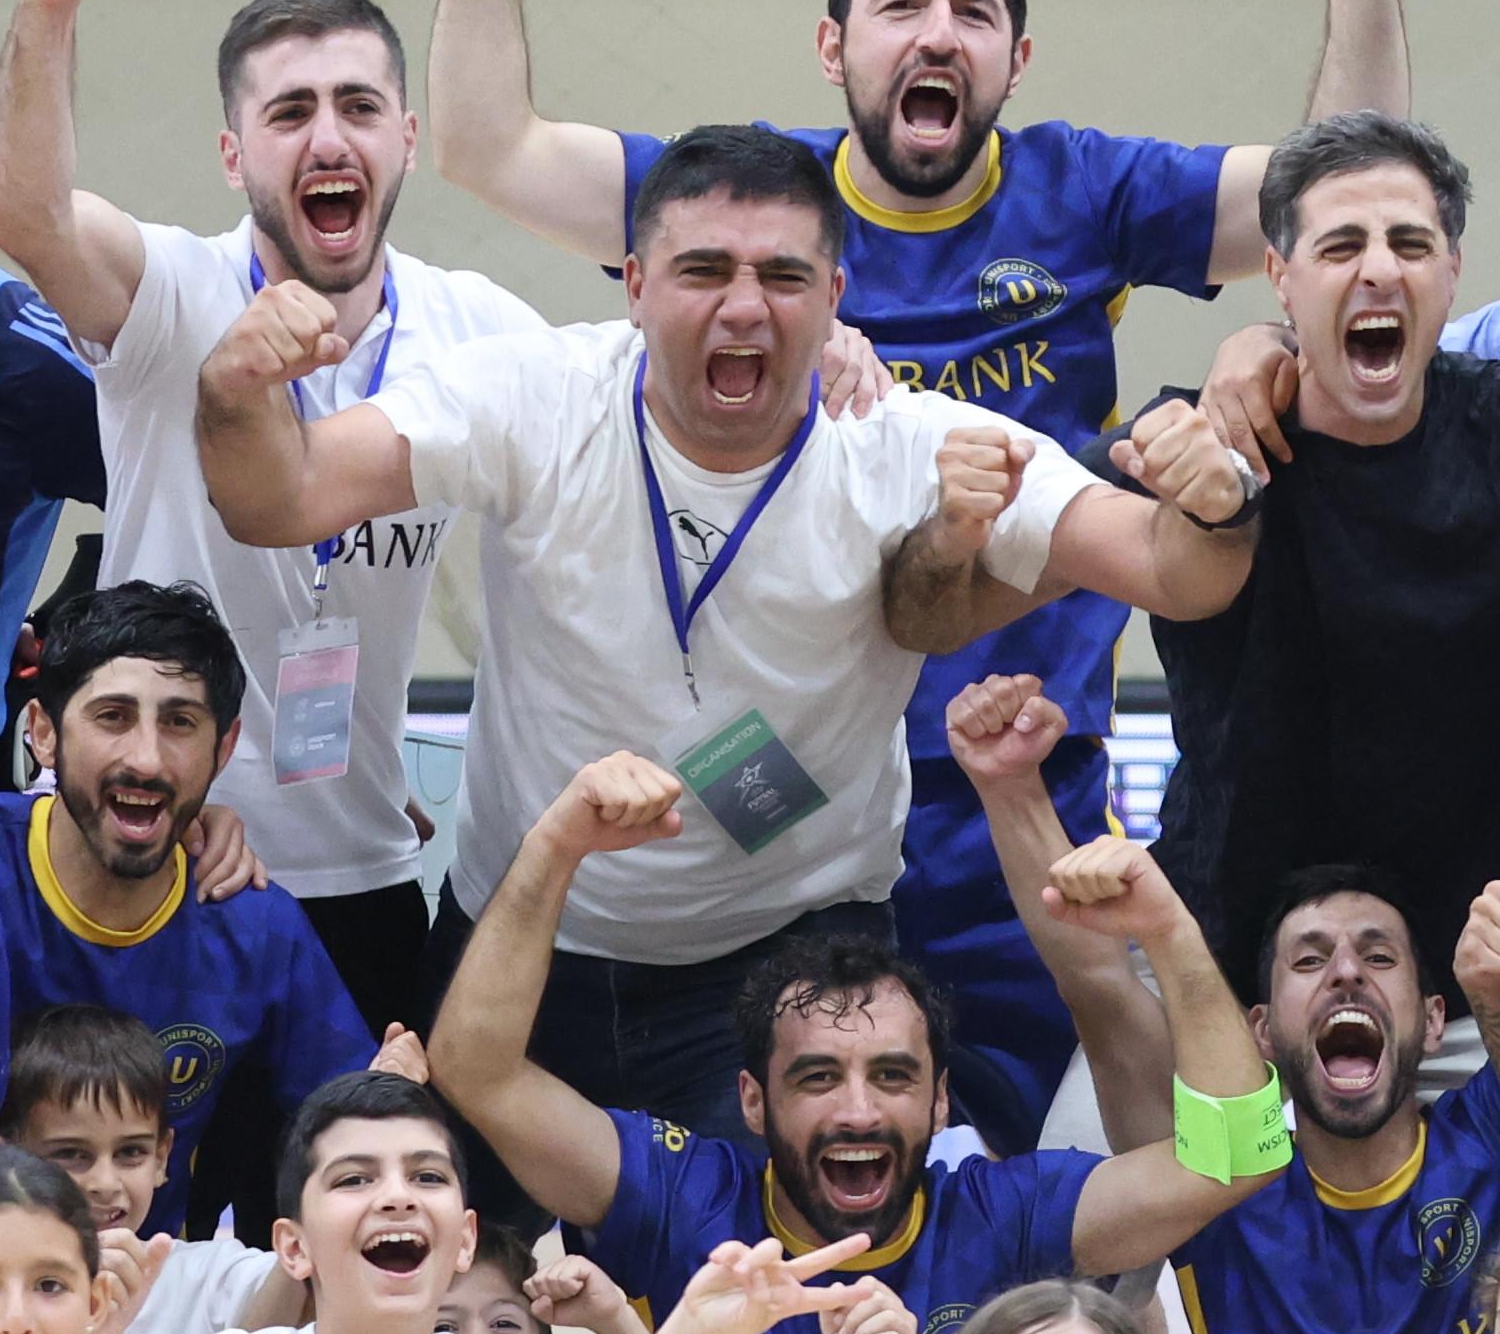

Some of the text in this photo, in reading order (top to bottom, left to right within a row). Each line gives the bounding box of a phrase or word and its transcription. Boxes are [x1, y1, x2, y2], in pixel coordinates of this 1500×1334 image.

[1006, 280, 1037, 304] U
[890, 341, 1056, 401] BANK
[171, 1056, 197, 1084] U
